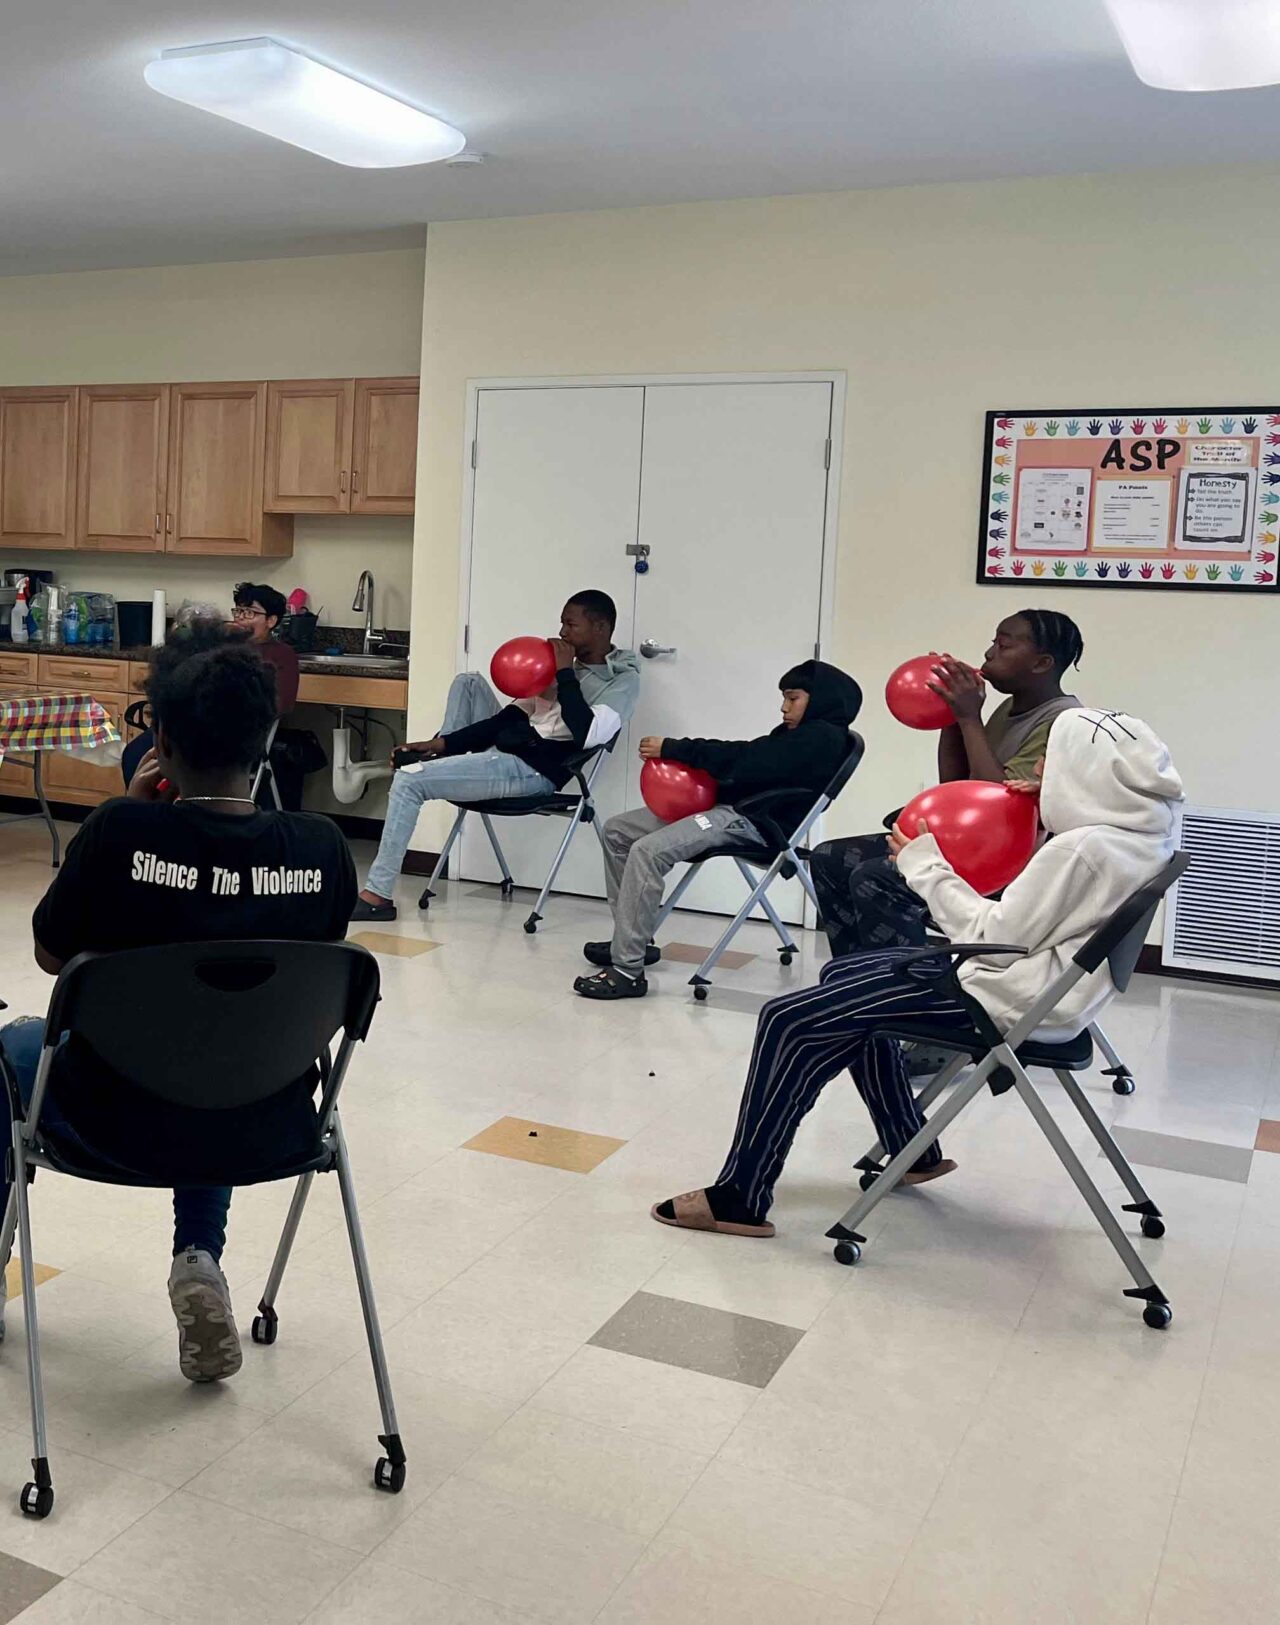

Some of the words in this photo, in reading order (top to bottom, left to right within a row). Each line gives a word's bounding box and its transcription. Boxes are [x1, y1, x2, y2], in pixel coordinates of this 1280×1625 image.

[1100, 438, 1181, 473] ASP
[1199, 478, 1237, 489] Honesty
[131, 850, 198, 891] Silence
[211, 866, 240, 895] The
[251, 866, 322, 895] Violence
